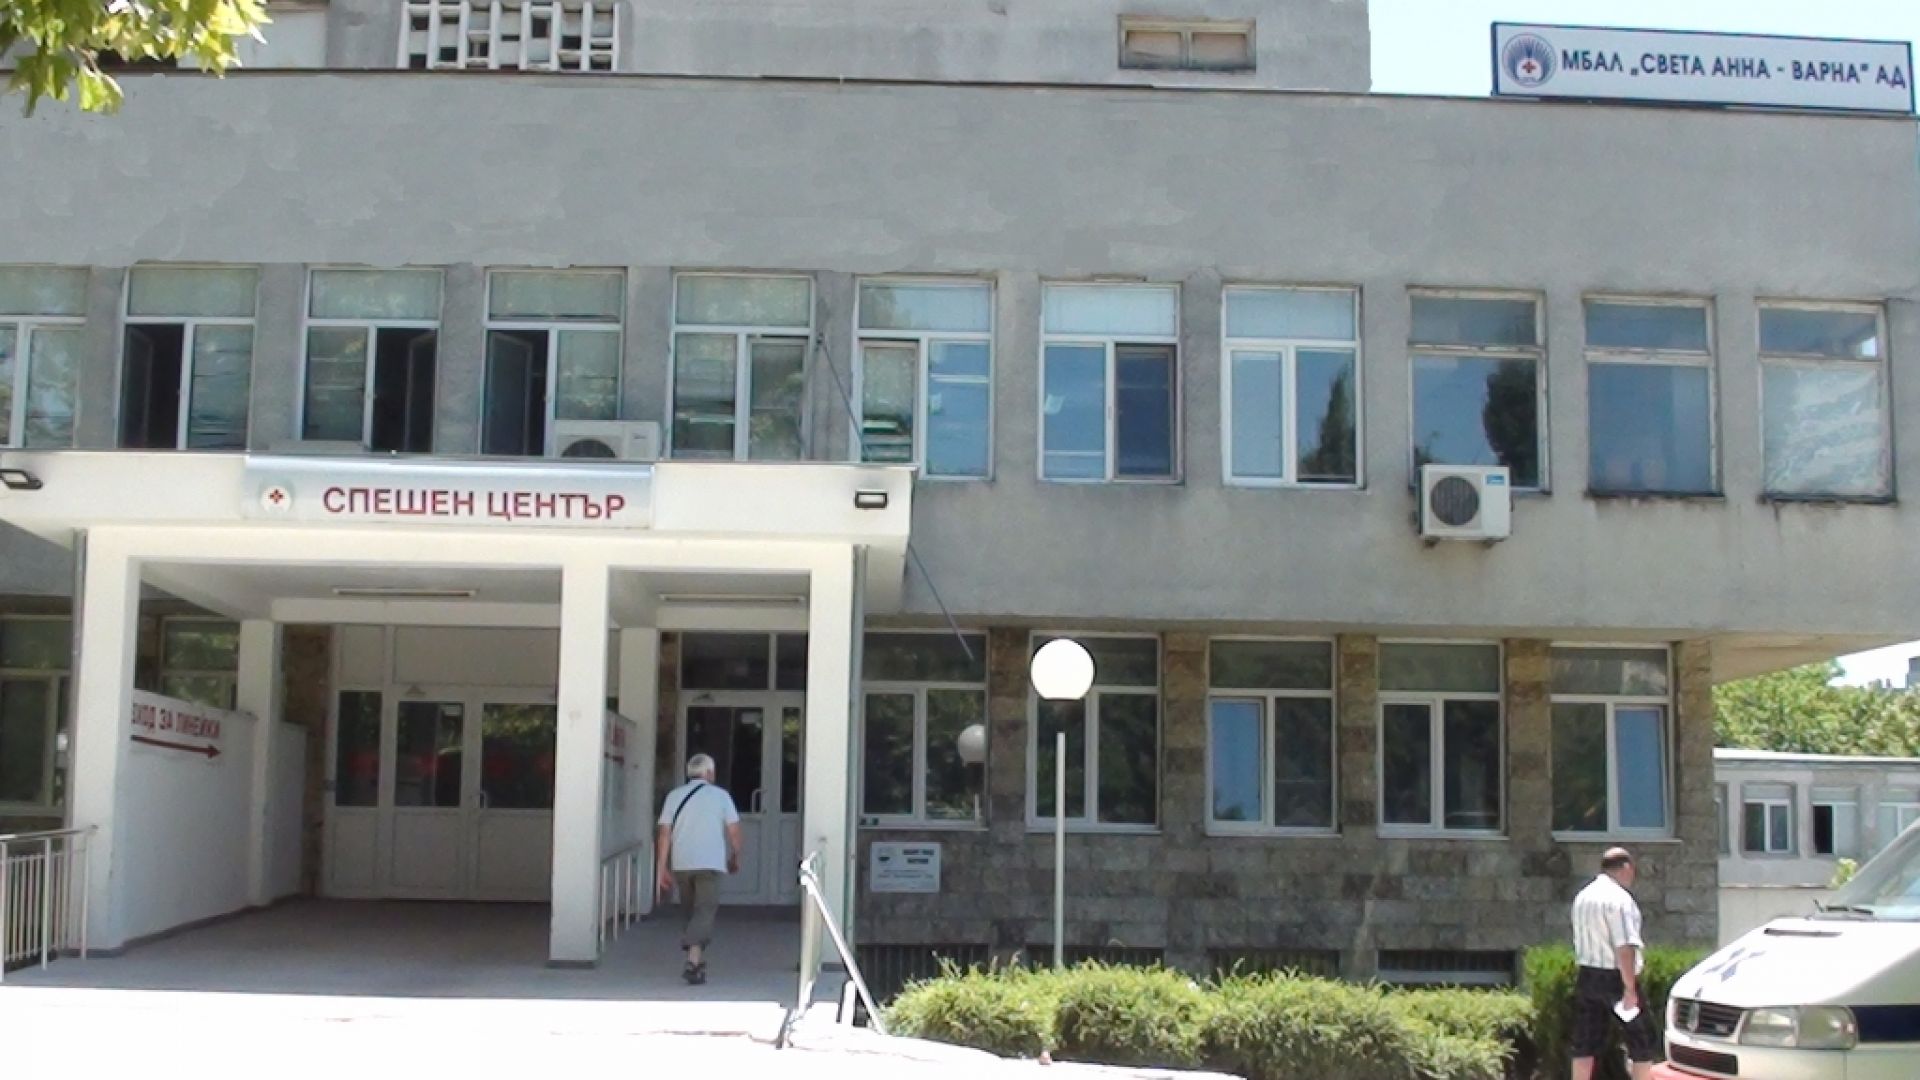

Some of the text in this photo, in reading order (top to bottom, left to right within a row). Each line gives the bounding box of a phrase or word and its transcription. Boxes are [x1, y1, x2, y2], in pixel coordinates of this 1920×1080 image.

[1561, 48, 1623, 72] МБАЛ
[1711, 55, 1771, 79] АННА
[1875, 63, 1907, 89] АД
[322, 487, 626, 521] СПЕШЕН ЦЕНТЪР
[159, 708, 173, 730] ЗА
